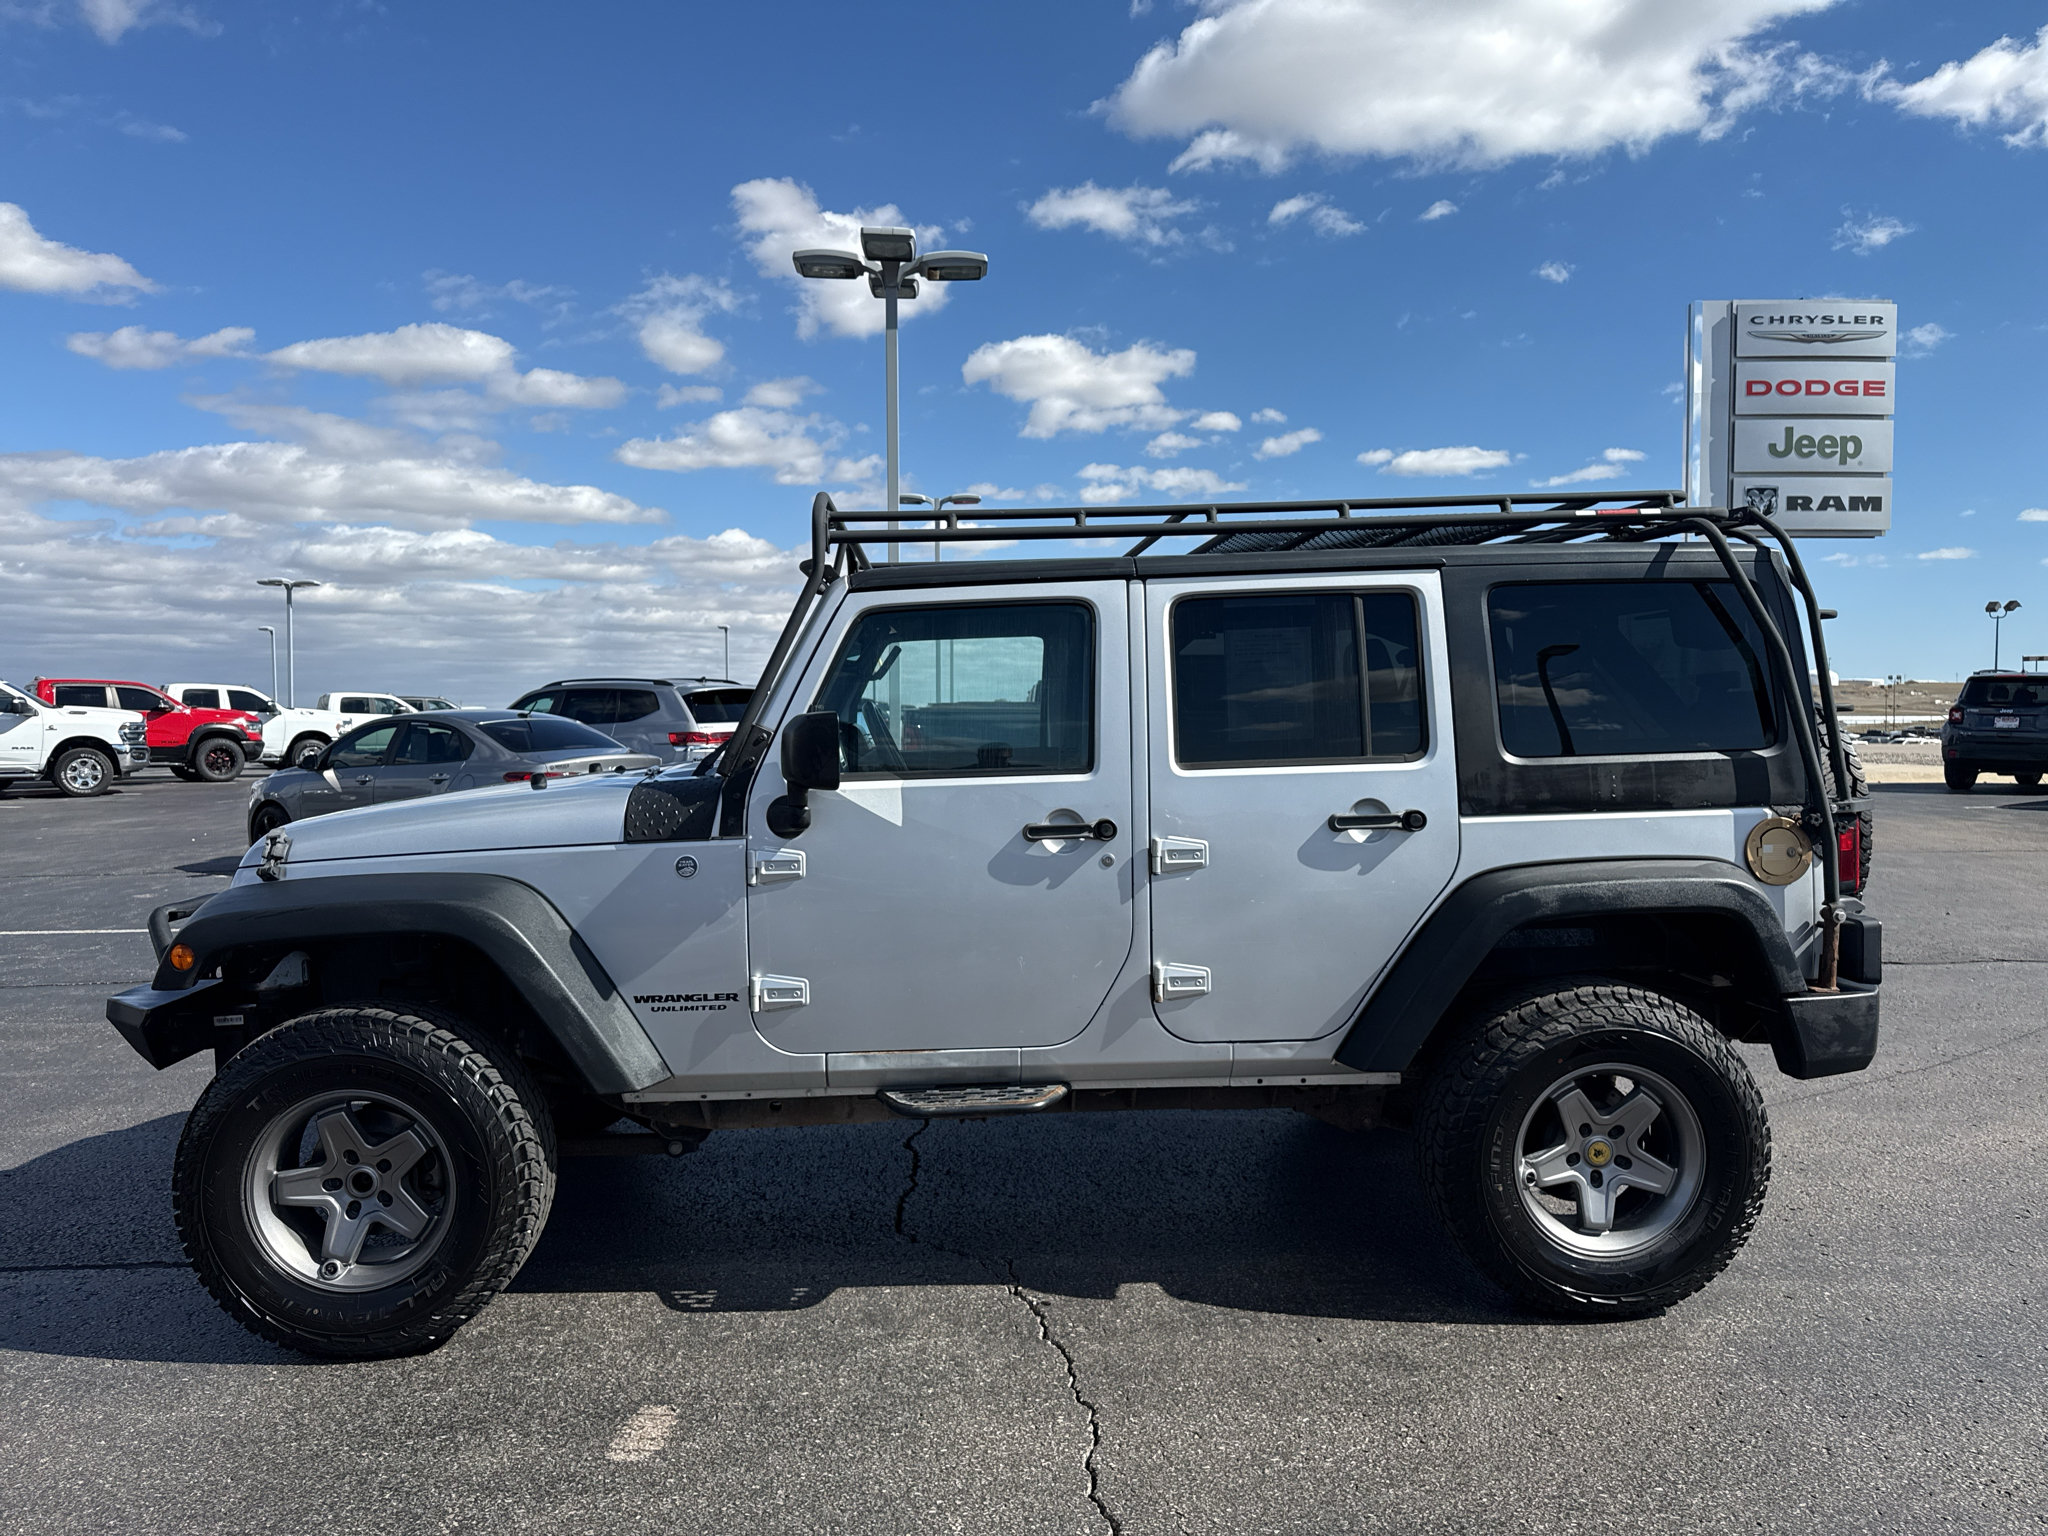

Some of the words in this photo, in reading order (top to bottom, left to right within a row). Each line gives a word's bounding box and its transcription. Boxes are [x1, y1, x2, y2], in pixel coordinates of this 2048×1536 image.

[1750, 315, 1884, 325] CHRYSLER
[1746, 380, 1886, 396] DODGE
[1768, 426, 1863, 466] Jeep
[1786, 496, 1883, 511] RAM
[633, 992, 740, 1004] WRANGLER
[650, 1004, 727, 1013] UNLIMITED
